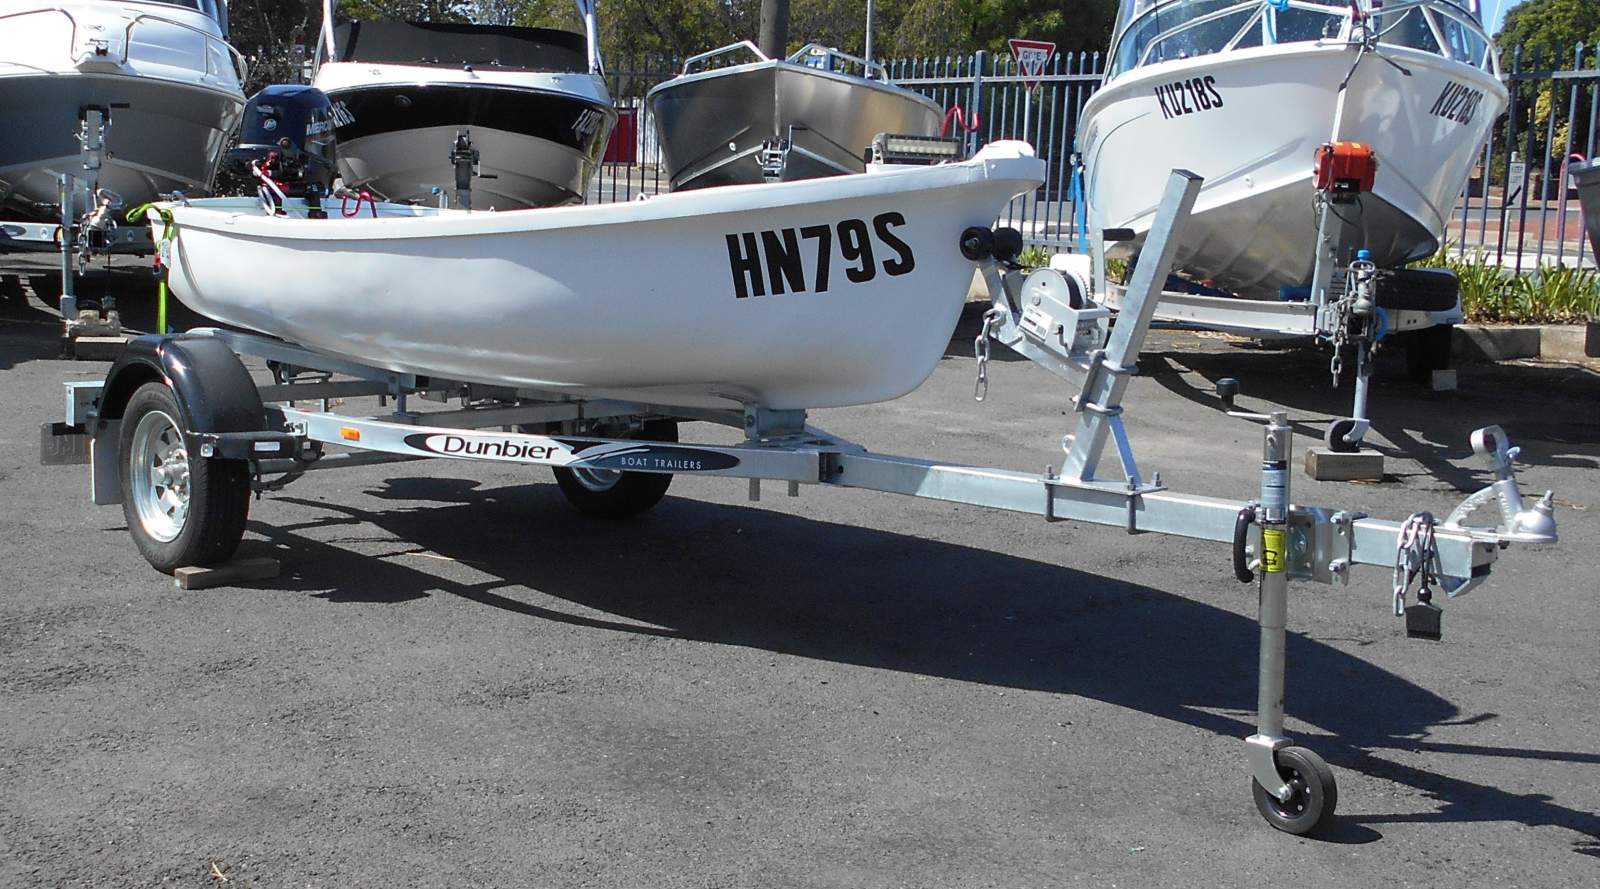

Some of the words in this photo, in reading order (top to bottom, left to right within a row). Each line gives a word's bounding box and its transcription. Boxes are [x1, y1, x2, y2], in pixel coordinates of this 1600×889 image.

[1154, 75, 1224, 119] KU218S
[725, 211, 916, 299] HN79S
[443, 436, 559, 459] Dunbier
[621, 456, 648, 467] BOAT
[655, 458, 702, 470] TRAILERS
